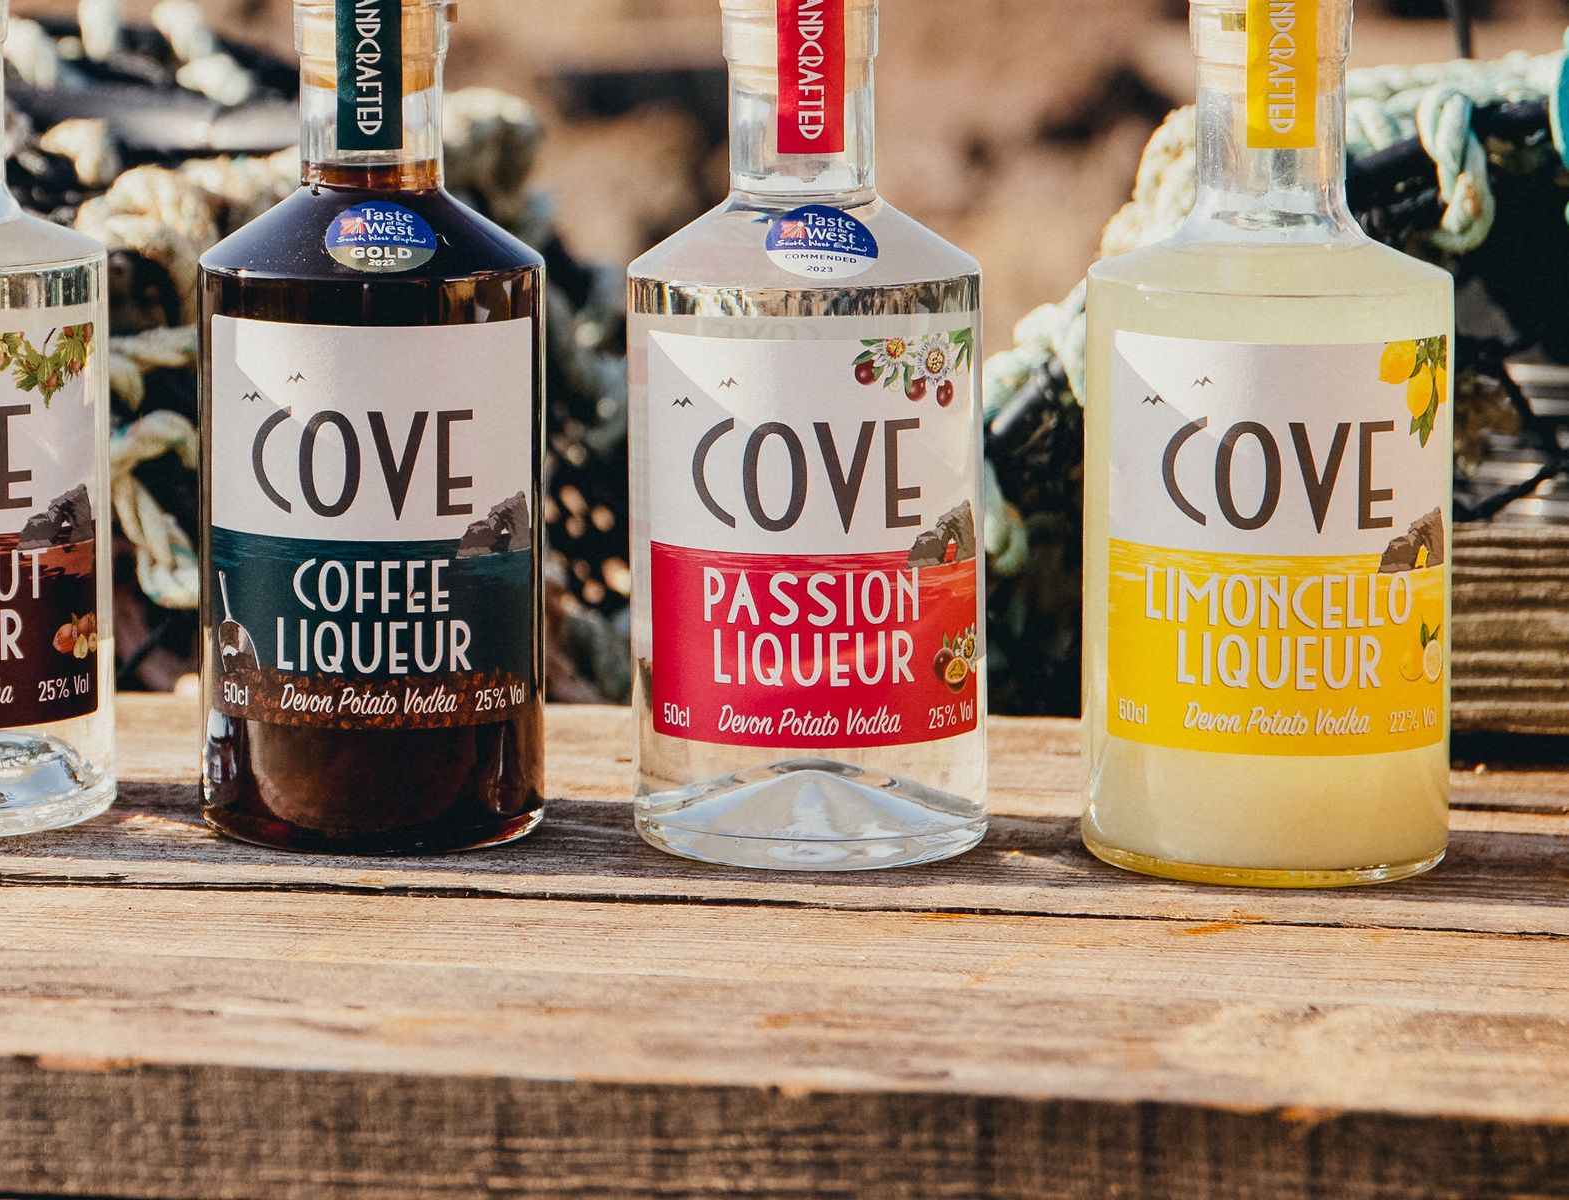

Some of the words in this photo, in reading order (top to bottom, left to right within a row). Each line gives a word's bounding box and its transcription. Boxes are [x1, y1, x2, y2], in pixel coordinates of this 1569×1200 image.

[362, 208, 413, 222] Taste
[364, 222, 414, 236] West
[804, 213, 856, 230] Taste
[805, 227, 856, 244] West
[350, 247, 412, 258] GOLD
[785, 253, 857, 263] COMMENDED
[252, 405, 473, 521] COVE
[692, 417, 921, 534] COVE
[1162, 416, 1394, 534] COVE
[293, 558, 449, 613] COFFEE
[703, 567, 919, 626] PASSION
[1145, 565, 1412, 630] LIMONCELLO
[276, 616, 472, 674] LIQUEUR
[713, 629, 915, 687] LIQUEUR
[1177, 629, 1381, 690] LIQUEUR
[38, 677, 69, 701] 25%
[74, 673, 89, 695] Vol
[224, 681, 248, 705] 50cl
[281, 683, 333, 713] Devon
[338, 687, 398, 715] Potato
[404, 684, 458, 713] Vodka
[475, 687, 506, 711] 25%
[510, 683, 525, 705] Vol
[664, 702, 690, 727] 50cl
[718, 704, 774, 734] Devon
[778, 708, 840, 736] Potato
[846, 705, 901, 735] Vodka
[928, 705, 957, 729] 25%
[960, 699, 973, 721] Vol
[1118, 698, 1147, 724] 50cl
[1183, 701, 1242, 733] Devon
[1245, 707, 1310, 735] Potato
[1315, 706, 1370, 735] Vodka
[1388, 709, 1419, 734] 22%
